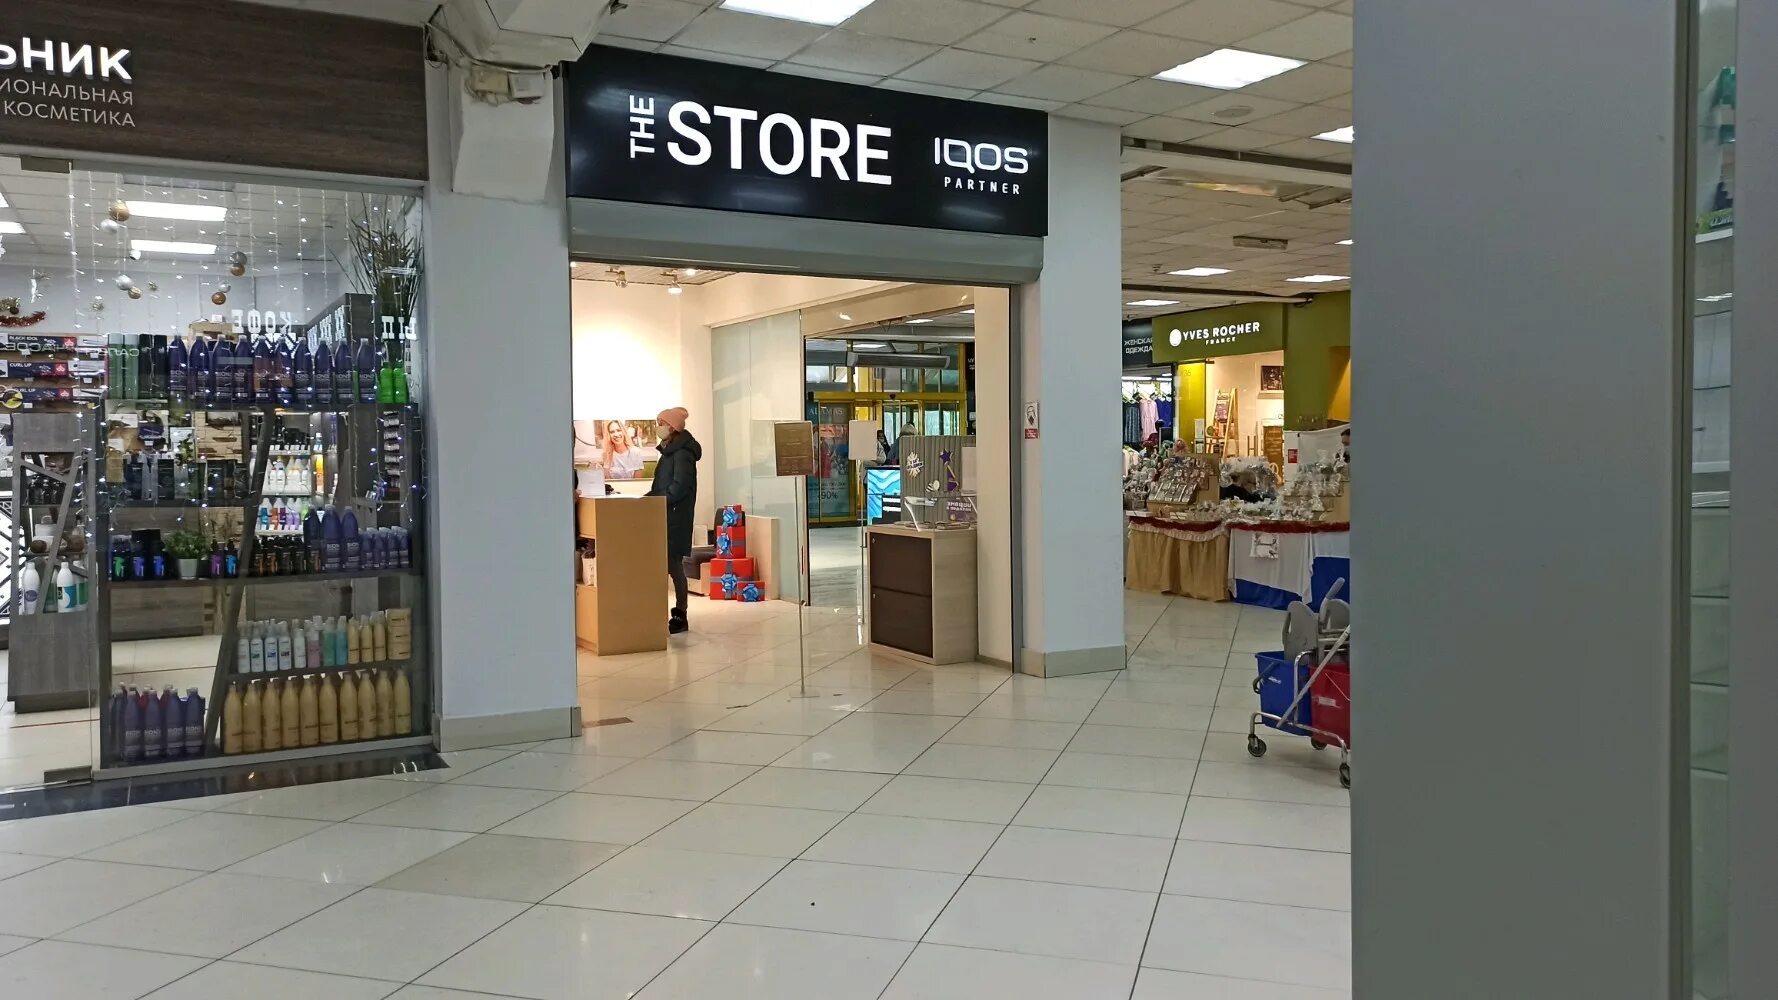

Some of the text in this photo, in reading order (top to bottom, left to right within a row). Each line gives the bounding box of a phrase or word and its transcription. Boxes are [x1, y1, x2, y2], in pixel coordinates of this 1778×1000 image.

[4, 100, 136, 127] КОСМЕТИКА
[629, 94, 892, 185] THE STORE
[934, 137, 1029, 174] IQOS
[944, 176, 1021, 195] PARTNER
[1182, 321, 1260, 341] YVES ROCHER
[1205, 336, 1236, 345] FRANCE
[1124, 336, 1152, 346] ЖЕНСКА
[1125, 345, 1153, 354] ОДЕЖДА
